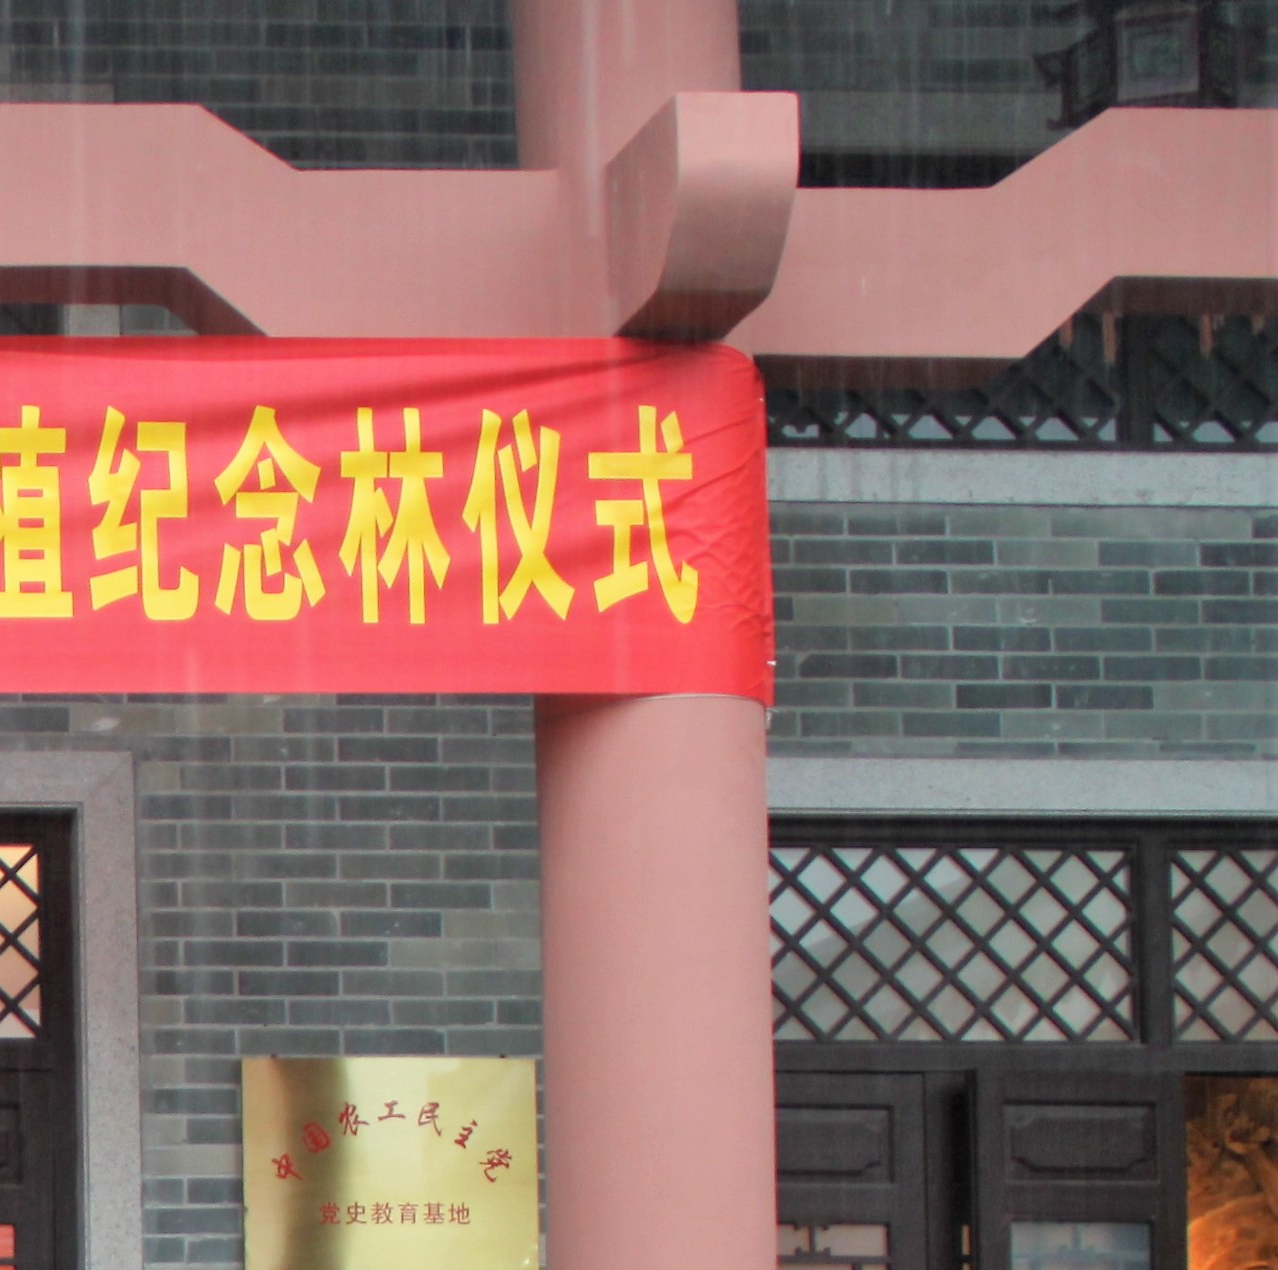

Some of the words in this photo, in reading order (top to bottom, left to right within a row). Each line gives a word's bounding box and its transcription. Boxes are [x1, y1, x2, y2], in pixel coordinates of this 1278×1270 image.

[318, 1201, 472, 1225] 党史教育基地
